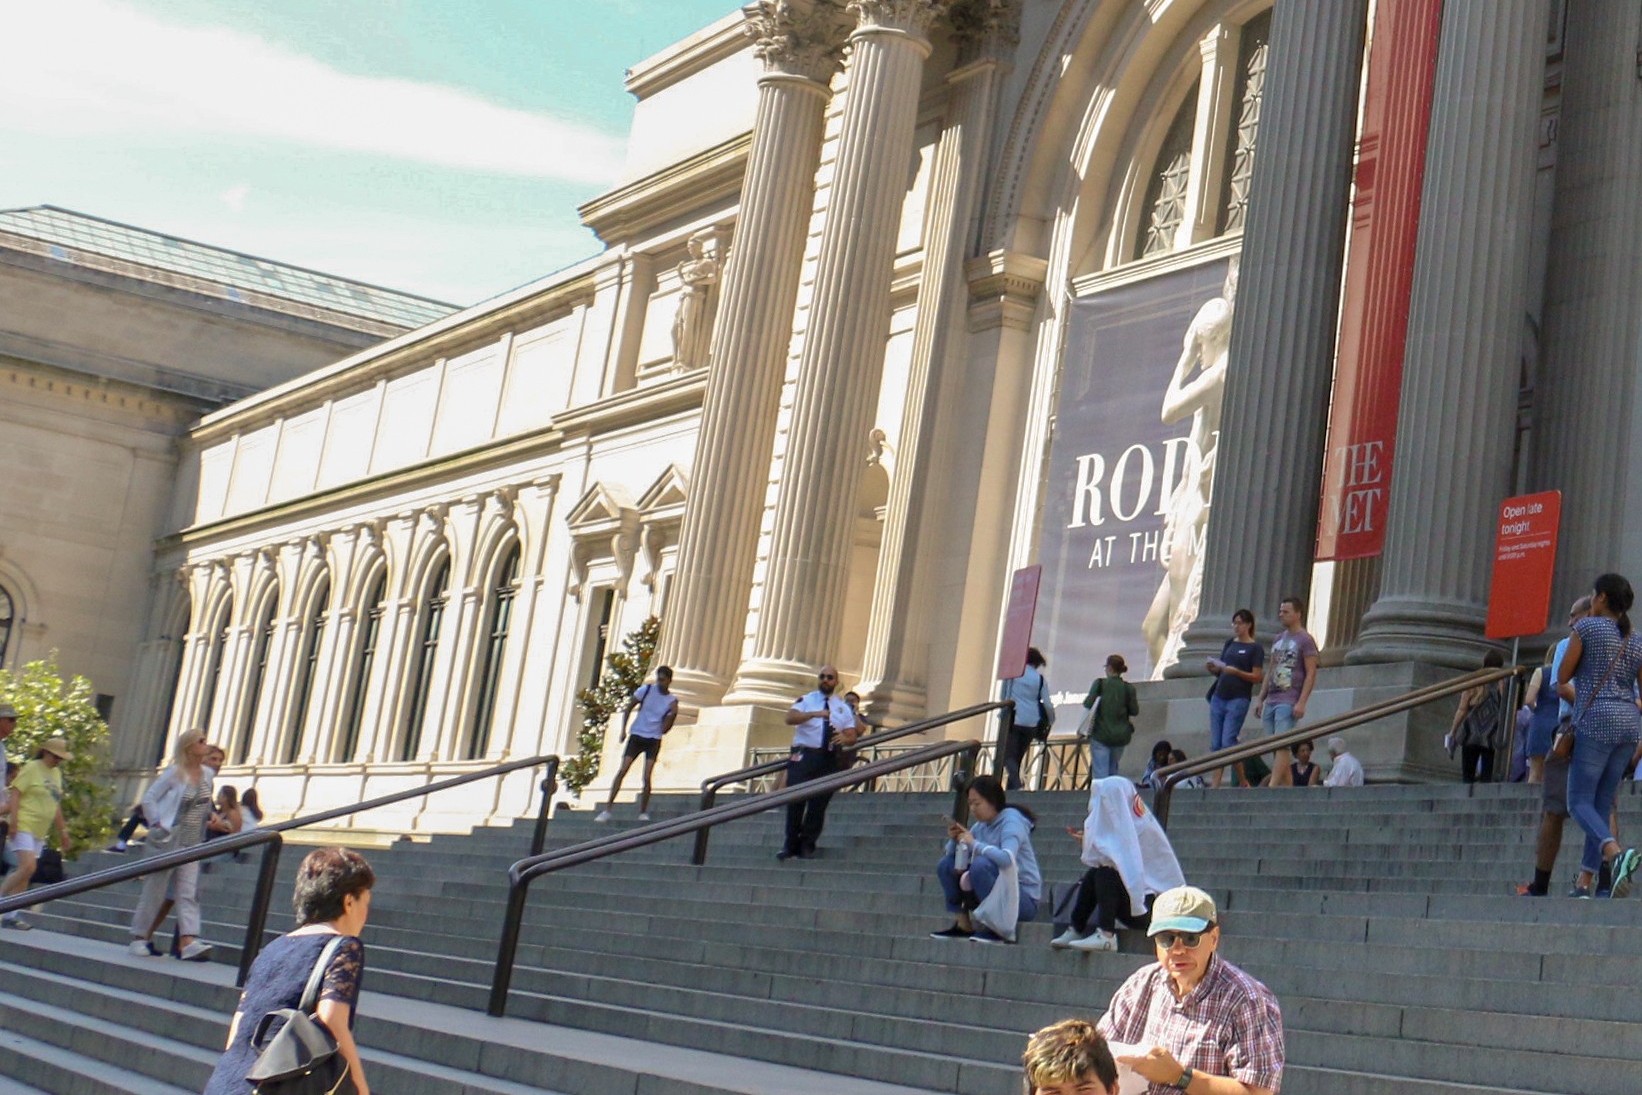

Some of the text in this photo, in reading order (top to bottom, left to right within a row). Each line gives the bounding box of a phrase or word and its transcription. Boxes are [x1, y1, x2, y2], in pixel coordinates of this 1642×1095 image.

[1067, 431, 1220, 528] ROD
[1335, 441, 1383, 489] THE
[1326, 488, 1381, 537] MET
[1501, 520, 1530, 535] tonight
[1503, 502, 1543, 519] Open late
[1089, 536, 1116, 569] AT
